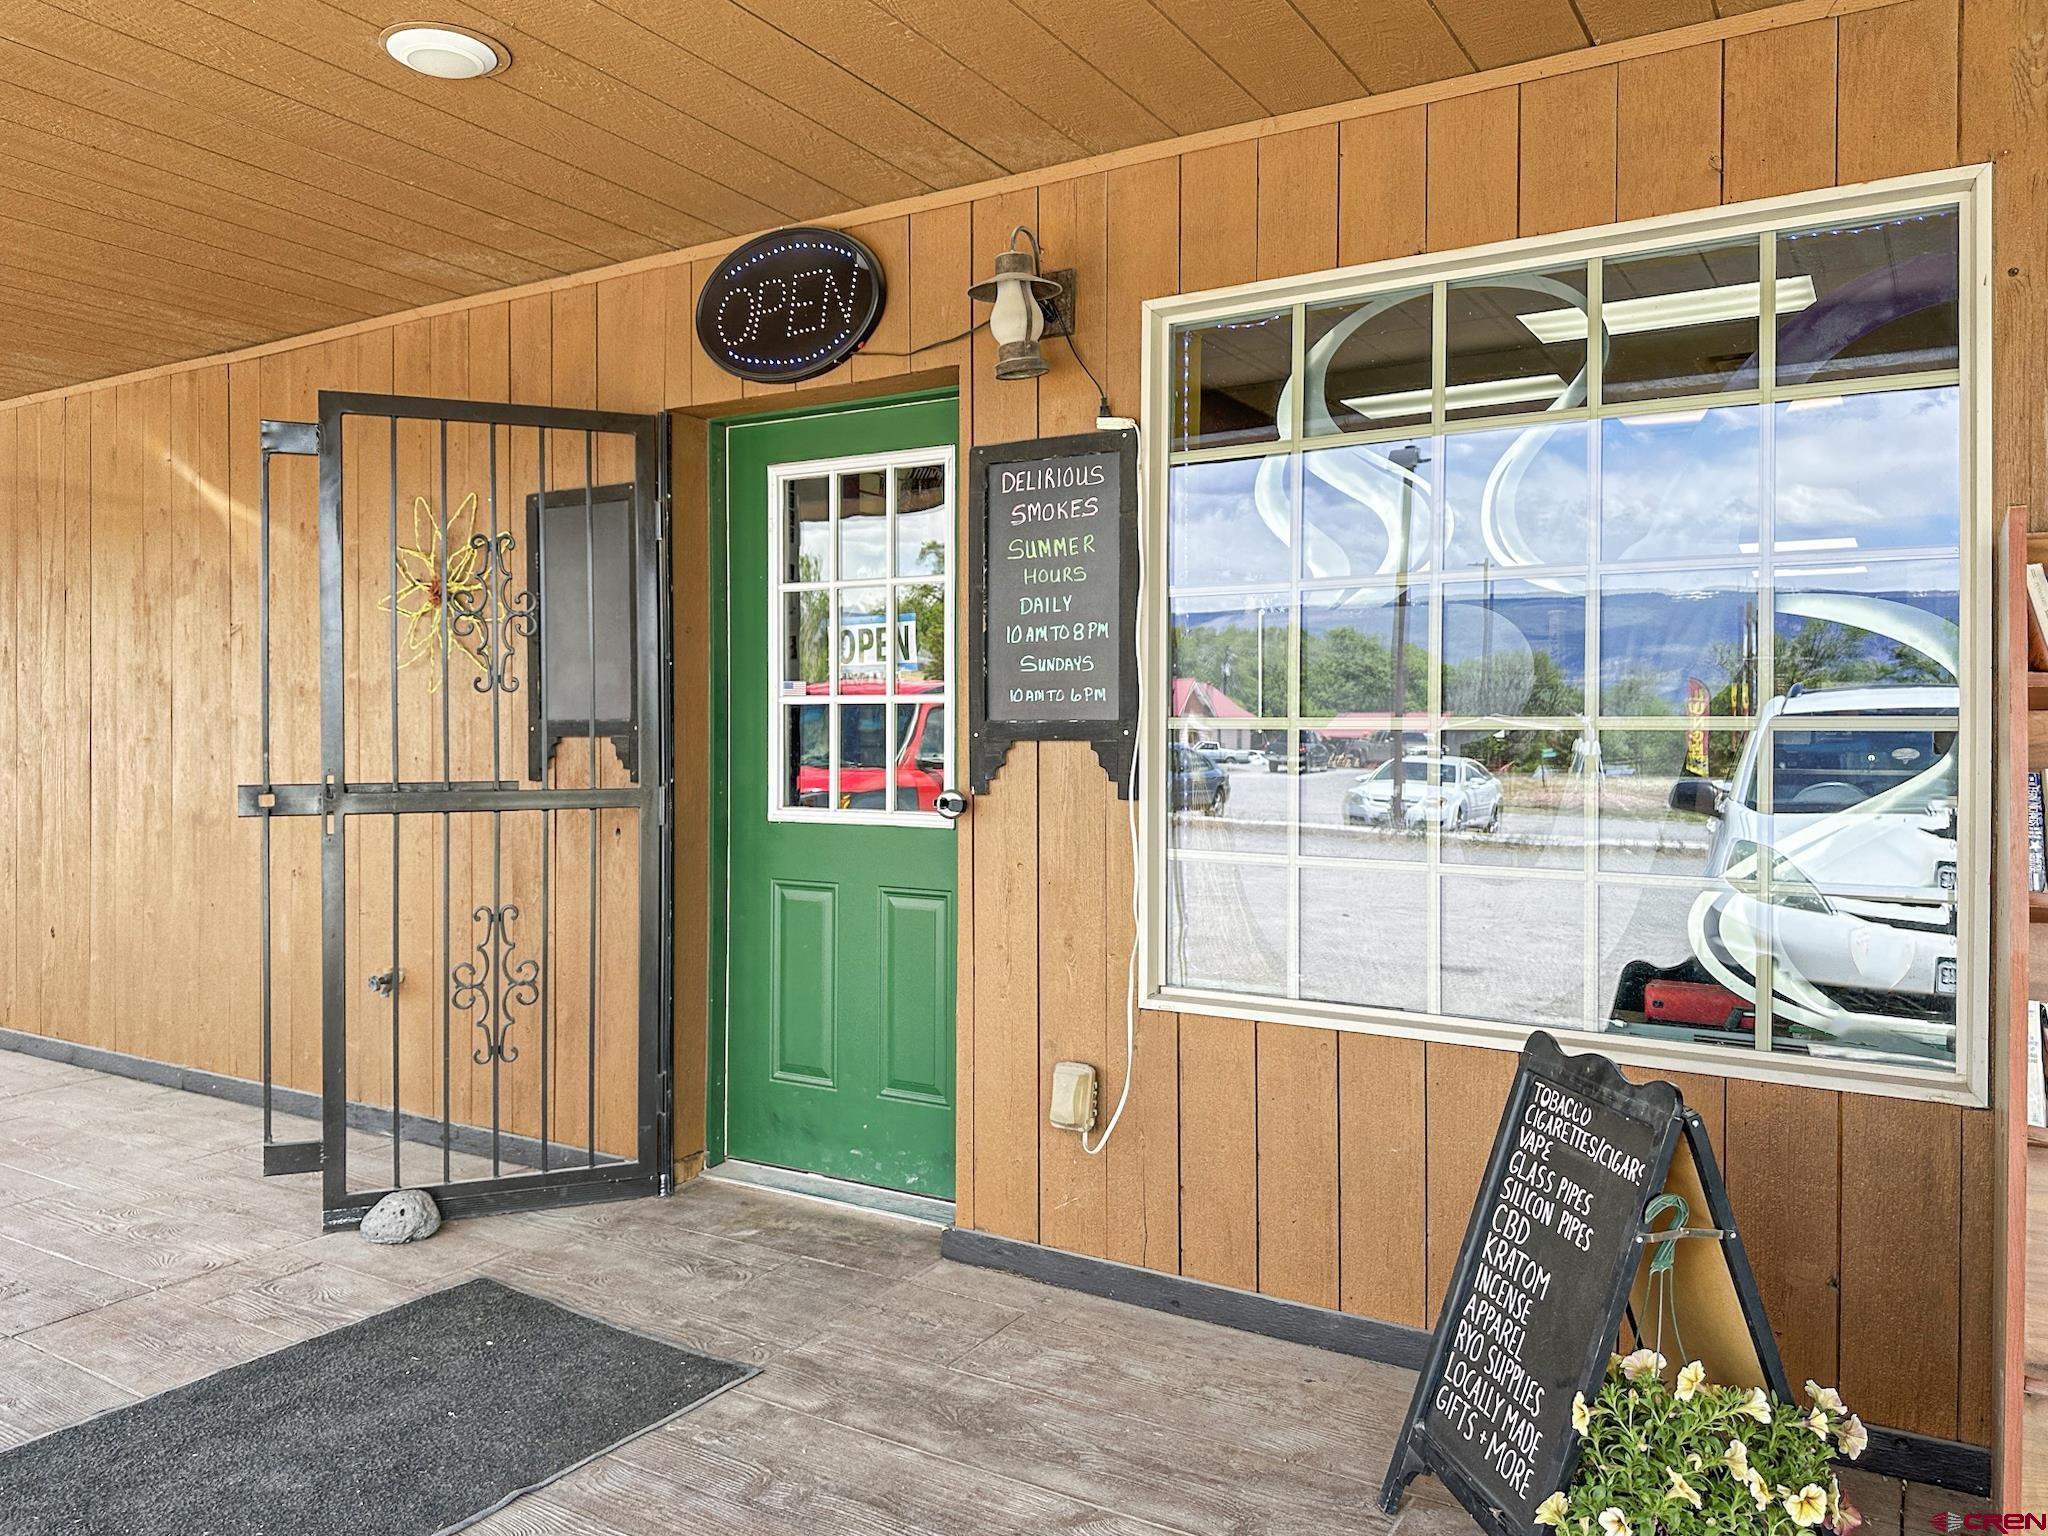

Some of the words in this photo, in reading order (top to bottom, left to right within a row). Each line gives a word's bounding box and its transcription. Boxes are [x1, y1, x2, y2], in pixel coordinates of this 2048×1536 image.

[717, 264, 859, 346] OPEN
[1002, 465, 1105, 494] DELIRIOUS
[1010, 497, 1099, 526] SMOKES
[1007, 534, 1095, 560] SUMMER
[1024, 566, 1087, 585] HOURS
[1020, 595, 1072, 615] DAILY
[840, 626, 910, 664] OPEN
[1006, 625, 1022, 643] 10
[1050, 624, 1070, 641] TO
[1073, 623, 1084, 640] 8
[1088, 622, 1109, 639] PM
[1020, 655, 1095, 672] SUNDAYS
[1009, 688, 1023, 702] 10
[1046, 689, 1065, 702] TO
[1071, 688, 1082, 702] 6
[1083, 686, 1106, 702] PM
[1535, 1081, 1592, 1126] TOBACCO
[1519, 1126, 1554, 1161] VAPE
[1509, 1150, 1556, 1193] GLASS
[1555, 1177, 1594, 1216] PIPES
[1492, 1204, 1531, 1245] CBD
[1500, 1177, 1555, 1226] SILICON
[1557, 1210, 1594, 1251] PIPES
[1482, 1231, 1551, 1301] KRATOM
[1473, 1262, 1533, 1325] INCENSE
[1463, 1293, 1526, 1362] APPAREL
[1454, 1318, 1485, 1361] RYO
[1483, 1345, 1545, 1417] SUPPLIES
[1444, 1351, 1506, 1423] LOCALLY
[1501, 1404, 1543, 1463] MADE
[1436, 1385, 1478, 1440] GIFTS
[1484, 1432, 1534, 1500] MORE
